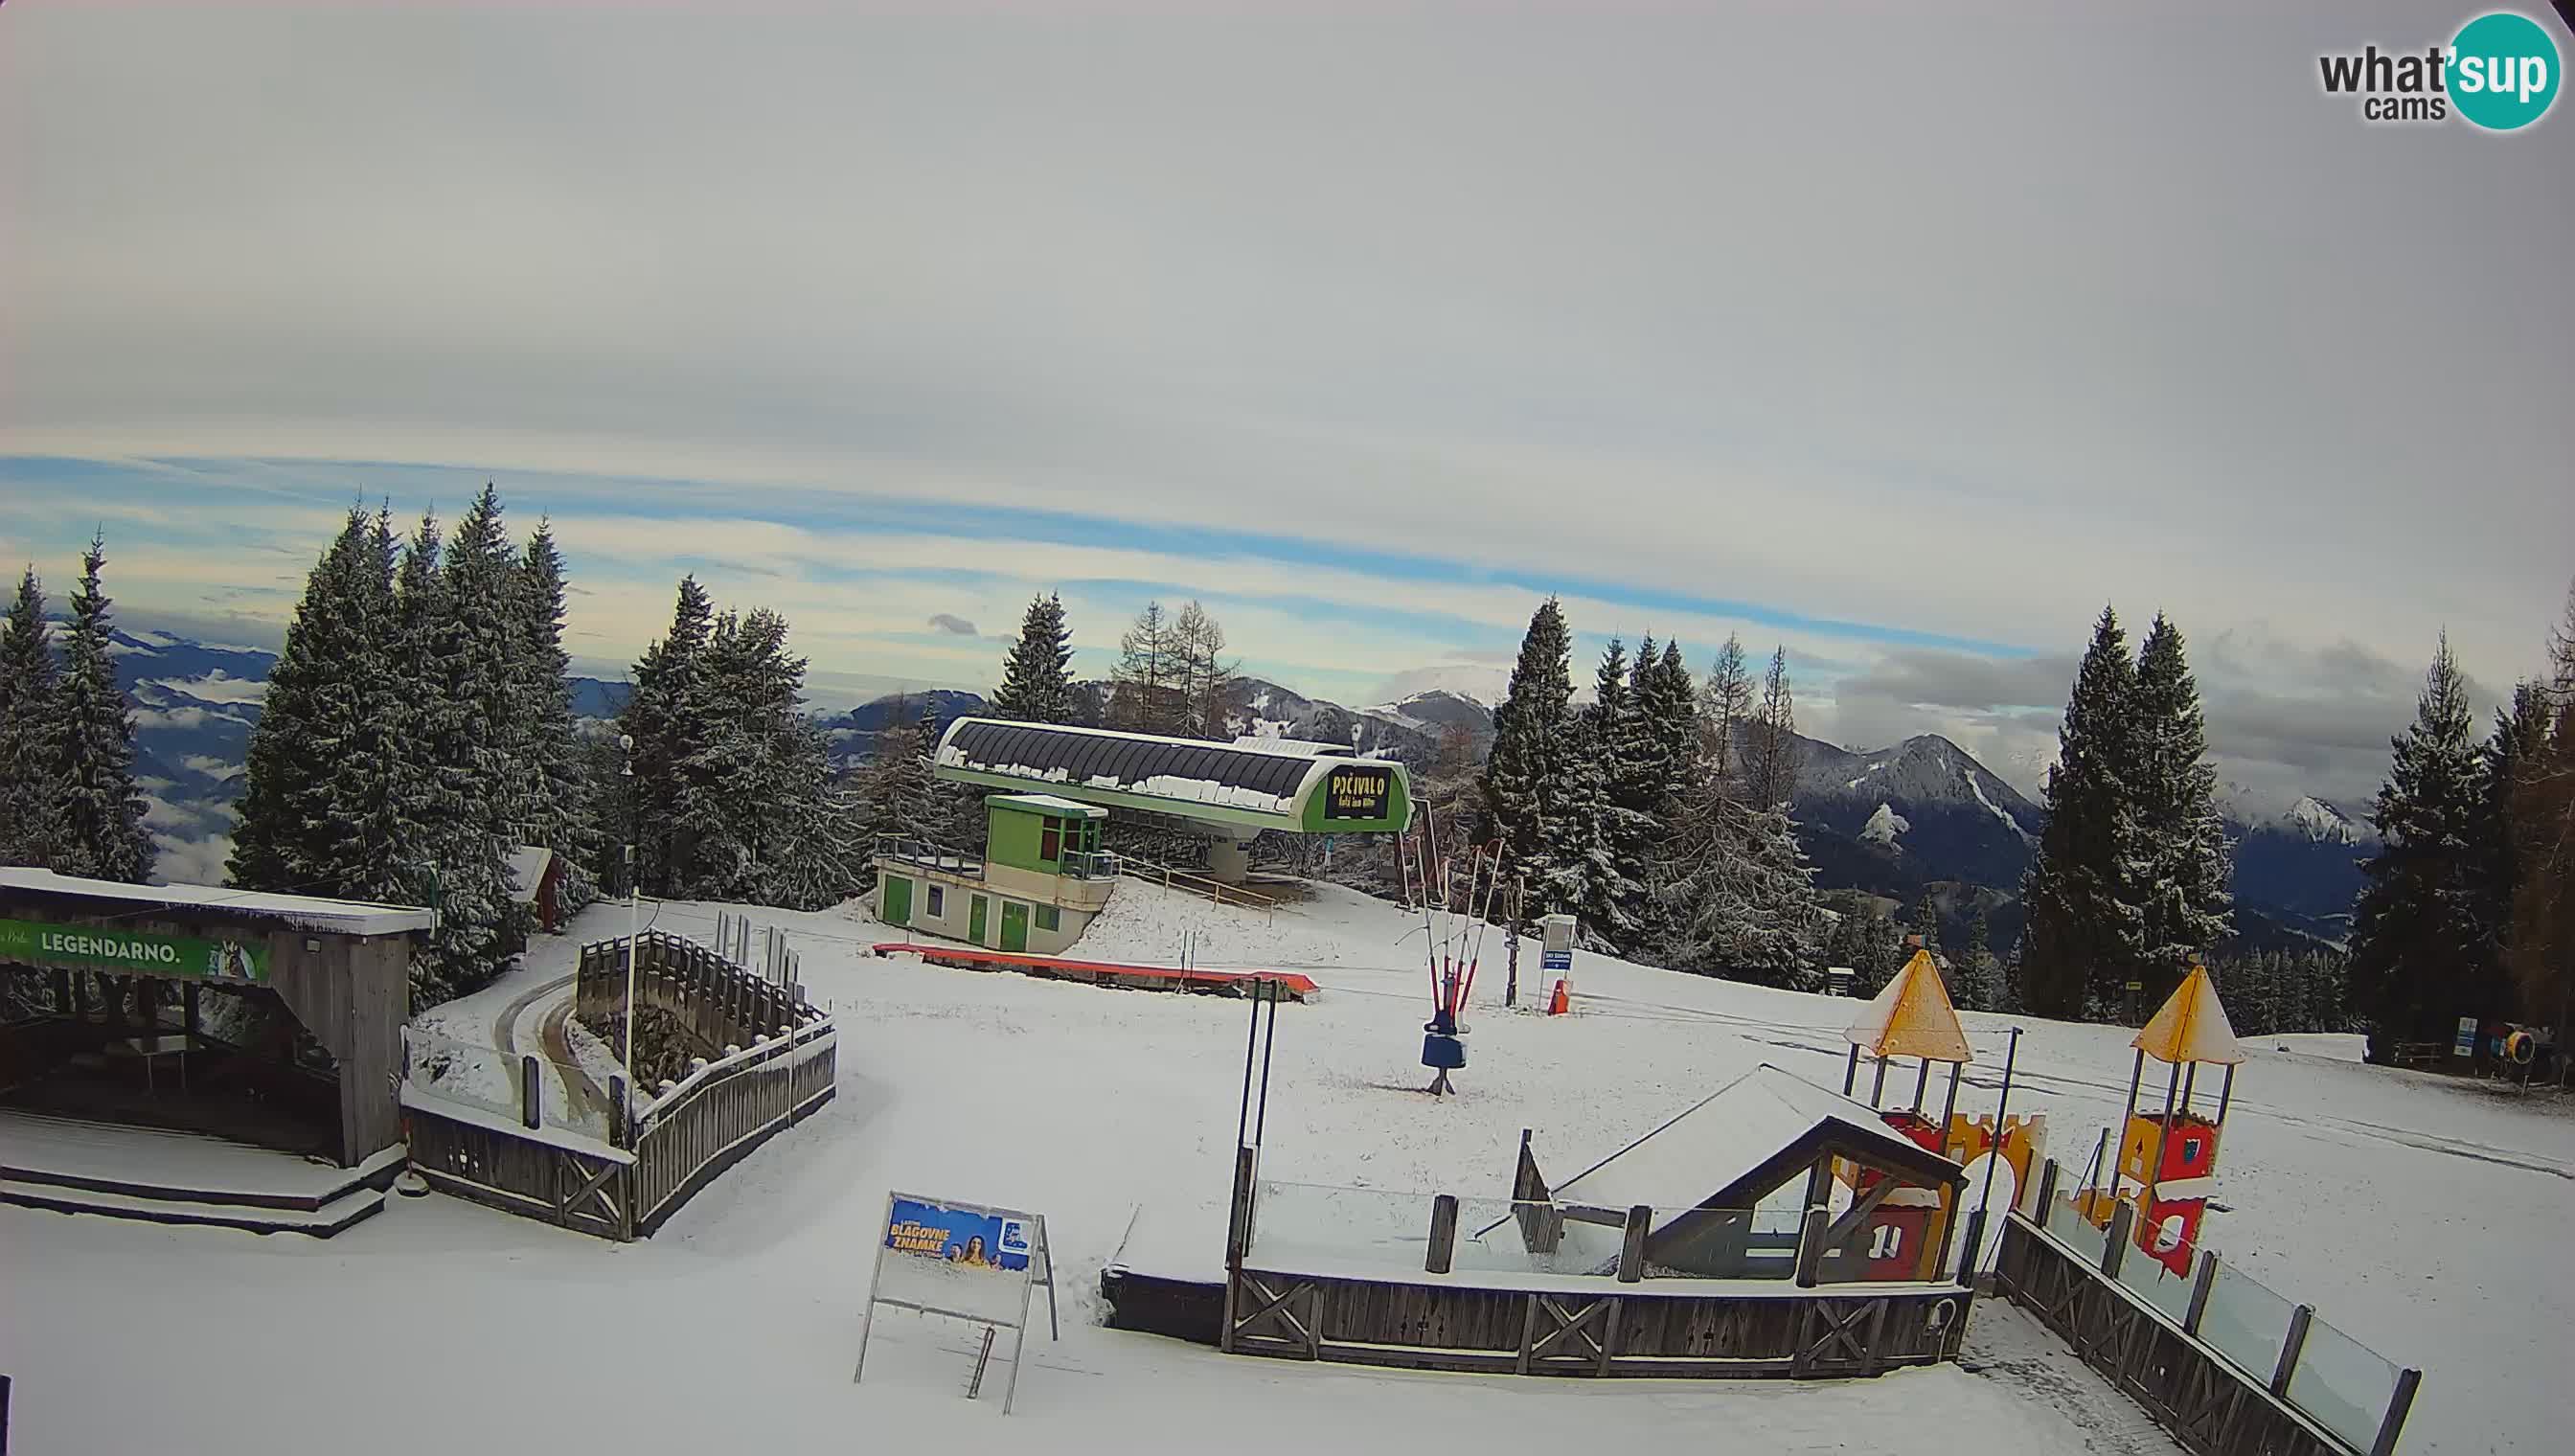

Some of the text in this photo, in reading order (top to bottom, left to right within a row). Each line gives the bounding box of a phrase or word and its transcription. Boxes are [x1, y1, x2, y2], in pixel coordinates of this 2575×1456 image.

[41, 932, 181, 964] LEGENDARNO.
[890, 1223, 951, 1241] BLAGOVNE
[893, 1236, 944, 1251] ZNAMKE
